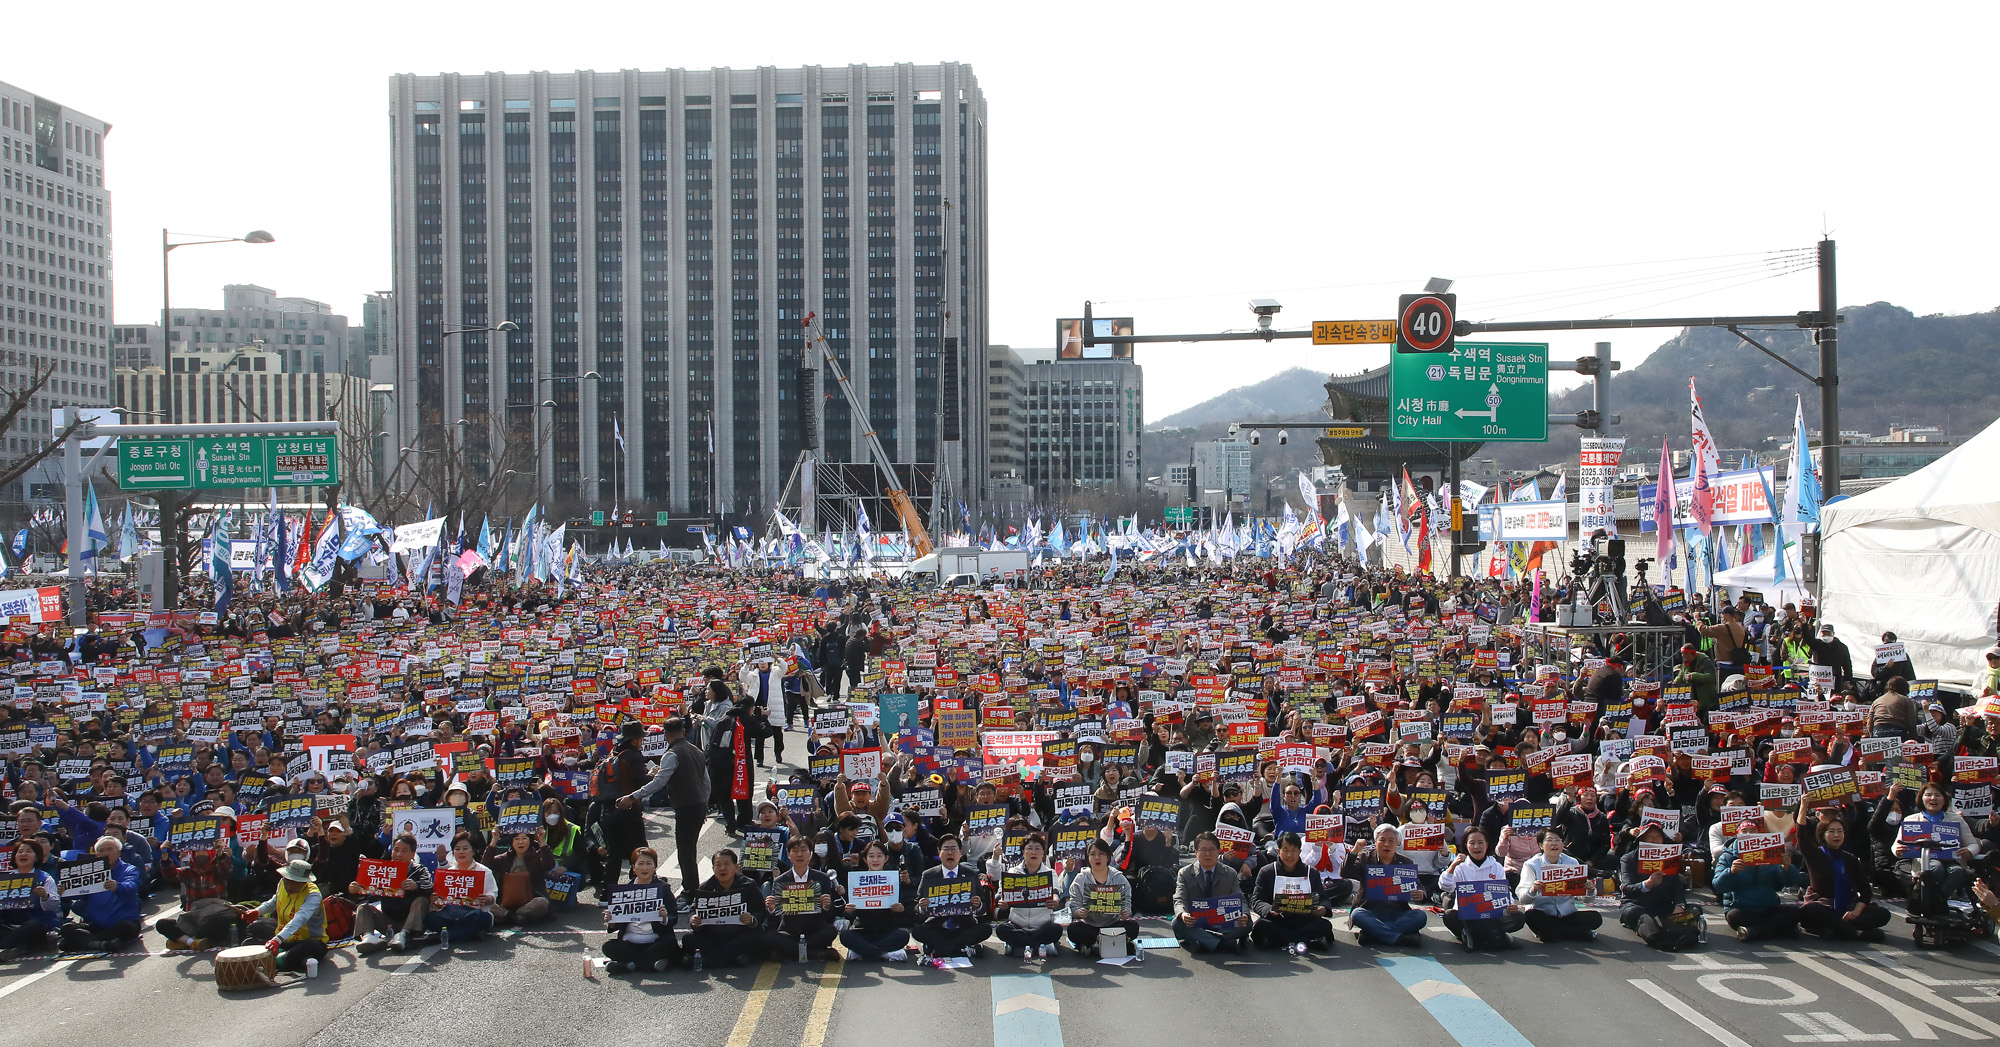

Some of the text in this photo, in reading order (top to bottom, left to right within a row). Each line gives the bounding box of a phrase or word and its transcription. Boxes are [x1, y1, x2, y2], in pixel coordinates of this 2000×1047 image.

[1414, 312, 1441, 336] 40
[1317, 324, 1393, 341] 과속단속장비
[1449, 348, 1491, 362] 수색역
[1496, 353, 1542, 363] Susaek Stn
[1431, 368, 1441, 377] 21
[1448, 366, 1491, 381] 독립문
[1497, 364, 1526, 374] 獨立門
[1497, 376, 1544, 386] Dongnimmun
[1397, 398, 1449, 412] 시청 市廳
[1488, 396, 1498, 405] 50
[1398, 415, 1441, 426] City Hall
[1483, 425, 1506, 435] 100m
[129, 446, 181, 459] 종로구청
[212, 442, 250, 453] 수색역
[277, 442, 326, 453] 삼청터널
[130, 463, 152, 471] Jongno
[155, 462, 167, 470] Dist
[277, 456, 328, 465] 국립민속 박물관
[212, 465, 235, 475] 광화문
[213, 476, 261, 484] Gwanghwamun
[41, 595, 59, 604] 진보당
[816, 710, 846, 720] 윤석열을
[1351, 712, 1379, 730] 내란수괴
[816, 720, 848, 729] 파면하라!
[1236, 725, 1258, 734] 윤석열
[1401, 722, 1429, 736] 내란농정
[1313, 727, 1345, 736] 내란수괴
[1673, 729, 1706, 739] 윤석열을
[987, 735, 1032, 744] 윤석열 즉각
[1229, 735, 1246, 743] 즉각
[1635, 738, 1664, 749] 내란수괴
[1673, 738, 1708, 748] 파면하라!
[1862, 738, 1898, 752] 내란농정
[159, 747, 192, 757] 내란 종식
[394, 741, 430, 758] 윤석열을
[988, 748, 1018, 756] 국민의힘
[1279, 747, 1313, 757] 극우국힘
[158, 754, 191, 764] 민주 수호
[395, 749, 434, 767] 파면하라!
[811, 758, 840, 768] 내란 종식
[850, 756, 876, 768] 윤석열
[1220, 755, 1254, 767] 내란 종식
[1278, 758, 1316, 767] 규탄한다!
[1693, 758, 1729, 768] 내란수괴
[498, 761, 534, 773] 내란 종식
[812, 765, 839, 775] 민주 수호
[1219, 763, 1253, 775] 민주 수호
[1553, 761, 1588, 776] 내란수괴
[1630, 757, 1663, 772] 내란수괴
[1954, 758, 1994, 771] 내란수괴
[498, 770, 533, 780] 민주 수호
[853, 768, 872, 778] 사형
[985, 765, 1018, 778] 내란수괴
[1490, 773, 1525, 786] 내란 종식
[1055, 785, 1091, 799] 윤석열을
[1490, 782, 1524, 794] 민주 수호
[1761, 785, 1799, 800] 내란농정
[1955, 786, 1991, 799] 김건희를
[901, 789, 939, 802] 김건희를
[1346, 790, 1381, 800] 내란 종식
[271, 798, 312, 813] 내란 종식
[1056, 795, 1093, 808] 파면하라!
[1346, 799, 1379, 809] 민주 수호
[270, 807, 311, 822] 민주 수호
[501, 804, 540, 818] 내란 종식
[969, 806, 1007, 821] 내란 종식
[1513, 808, 1553, 819] 내란 종식
[501, 814, 538, 826] 민주 수호
[969, 817, 1007, 829] 민주 수호
[1307, 817, 1341, 829] 내란수괴
[1512, 817, 1552, 828] 민주 수호
[172, 819, 217, 836] 내란 종식
[1405, 825, 1442, 838] 내란수괴
[171, 828, 215, 844] 민주 수호
[1309, 831, 1328, 840] 즉각
[1407, 839, 1426, 848] 즉각
[1738, 834, 1781, 852] 내란수괴
[1640, 846, 1679, 859] 내란수괴
[1742, 849, 1764, 864] 즉각
[60, 861, 104, 879] 윤석열을
[367, 864, 398, 878] 윤석열
[1642, 860, 1663, 871] 즉각
[61, 869, 110, 890] 파면하라!
[1542, 866, 1585, 881] 내란수괴
[369, 877, 391, 888] 파면
[444, 876, 475, 888] 윤석열
[860, 875, 887, 885] 헌재는
[1003, 875, 1048, 889] 윤석열을
[448, 886, 468, 898] 파면
[853, 884, 894, 897] 즉각파면!
[928, 881, 972, 899] 내란 종식
[1545, 881, 1566, 892] 즉각
[612, 888, 658, 904] 김건희를
[698, 893, 742, 909] 윤석열을
[928, 892, 971, 908] 민주 수호
[612, 900, 662, 916] 수사하라!
[698, 904, 746, 919] 파면하라!
